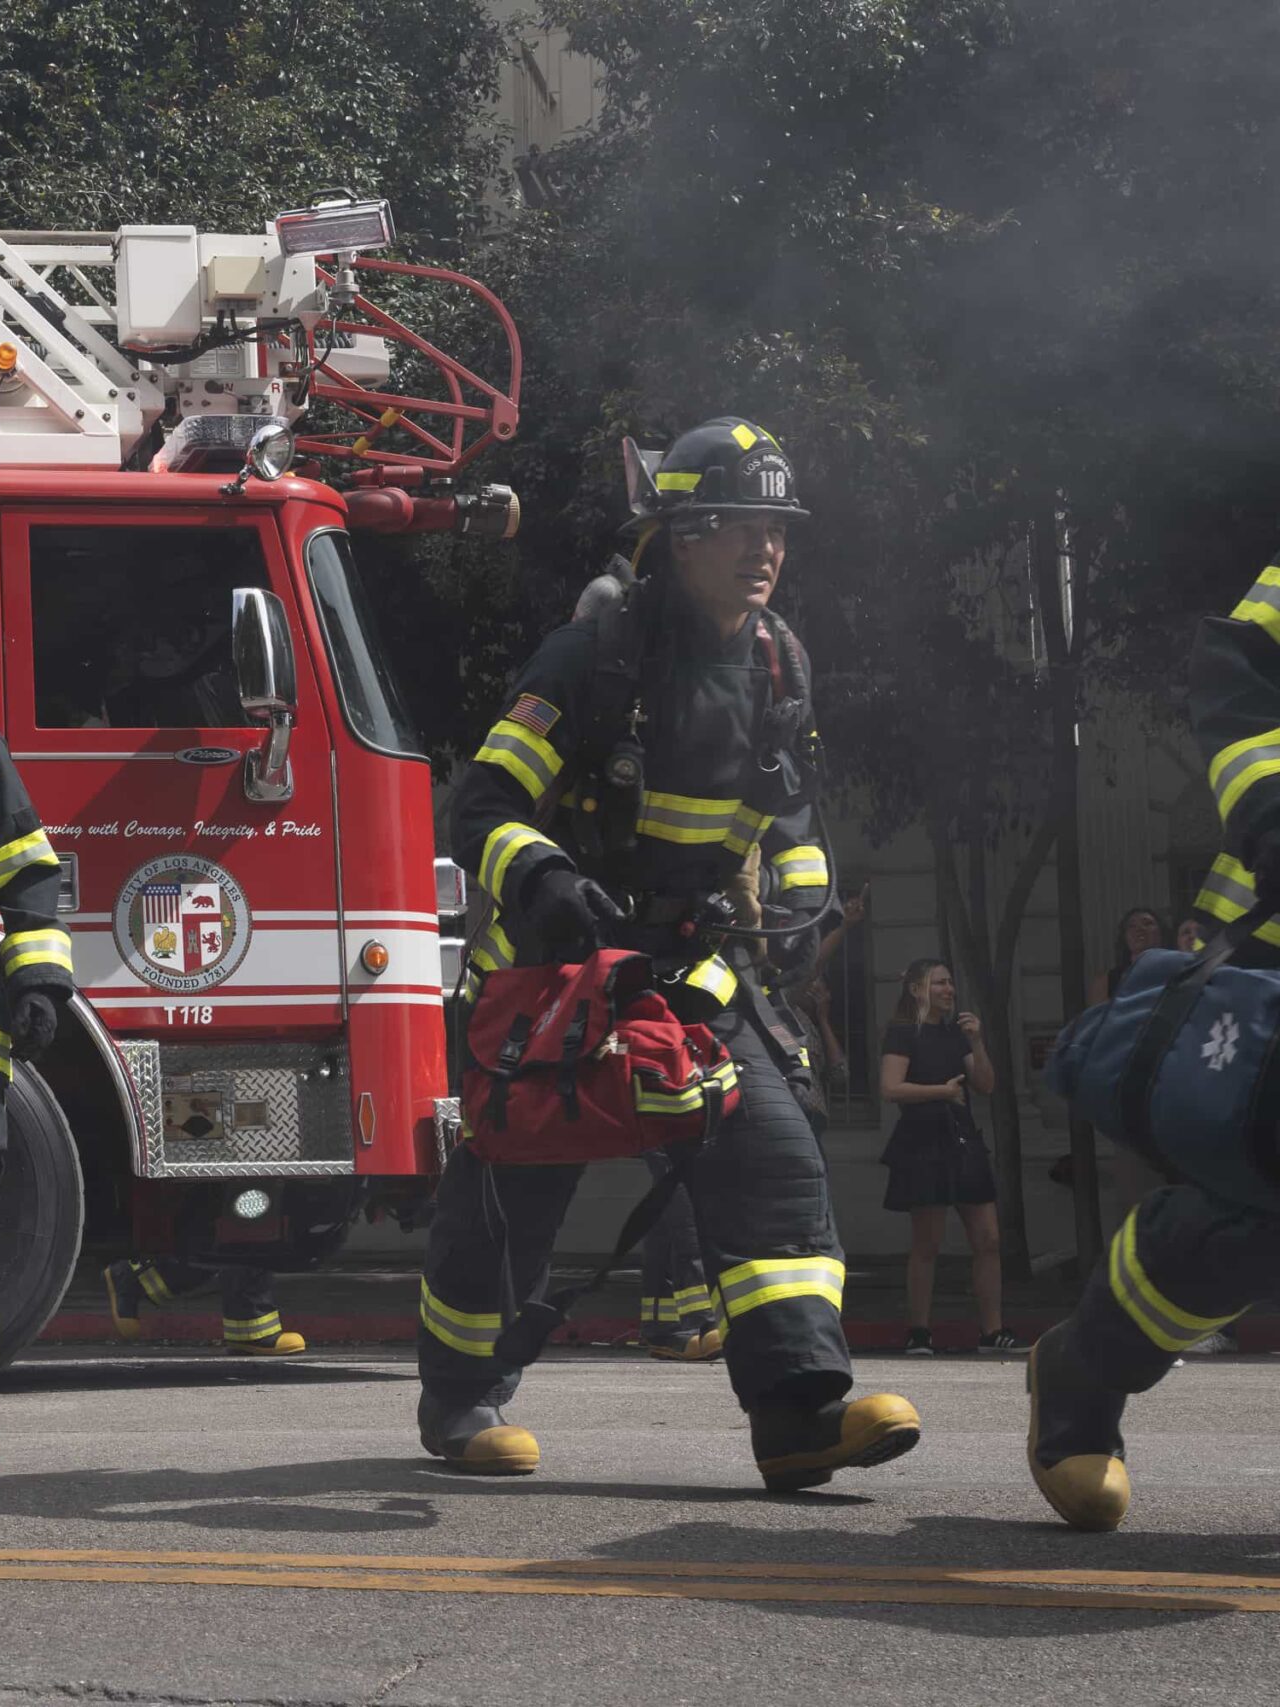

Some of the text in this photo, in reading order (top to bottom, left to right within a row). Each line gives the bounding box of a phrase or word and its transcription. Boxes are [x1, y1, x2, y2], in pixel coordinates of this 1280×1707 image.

[742, 459, 762, 477] LOS
[759, 470, 786, 498] 118
[39, 818, 84, 840] erving
[87, 820, 120, 836] with
[193, 819, 259, 840] Integrity,
[264, 820, 277, 837] &
[281, 820, 322, 837] Pride
[121, 857, 241, 904] CITY OF LOS ANGELES
[141, 965, 227, 989] FOUNDED 1781
